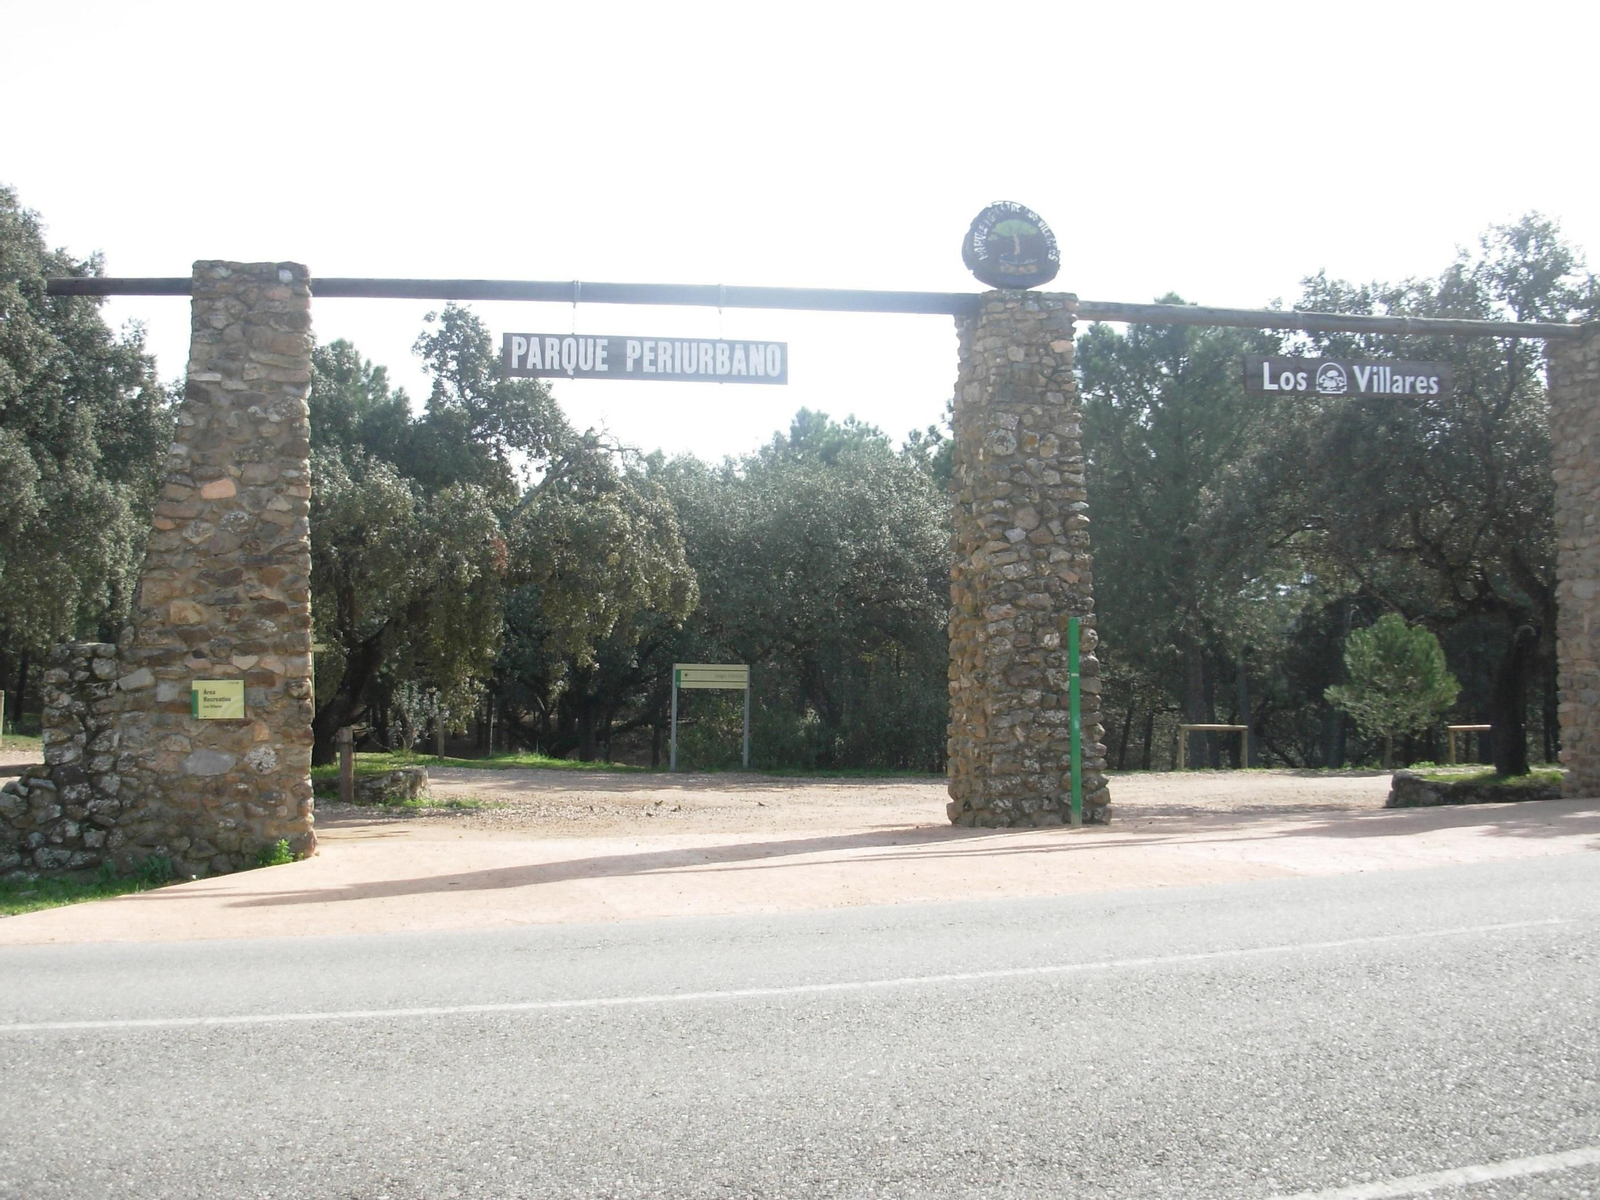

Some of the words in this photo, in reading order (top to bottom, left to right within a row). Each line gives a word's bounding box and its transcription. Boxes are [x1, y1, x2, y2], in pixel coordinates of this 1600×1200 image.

[511, 336, 609, 375] PARQUE
[626, 339, 781, 377] PERIURBANO
[1262, 361, 1308, 391] Los
[1352, 365, 1439, 394] Villares
